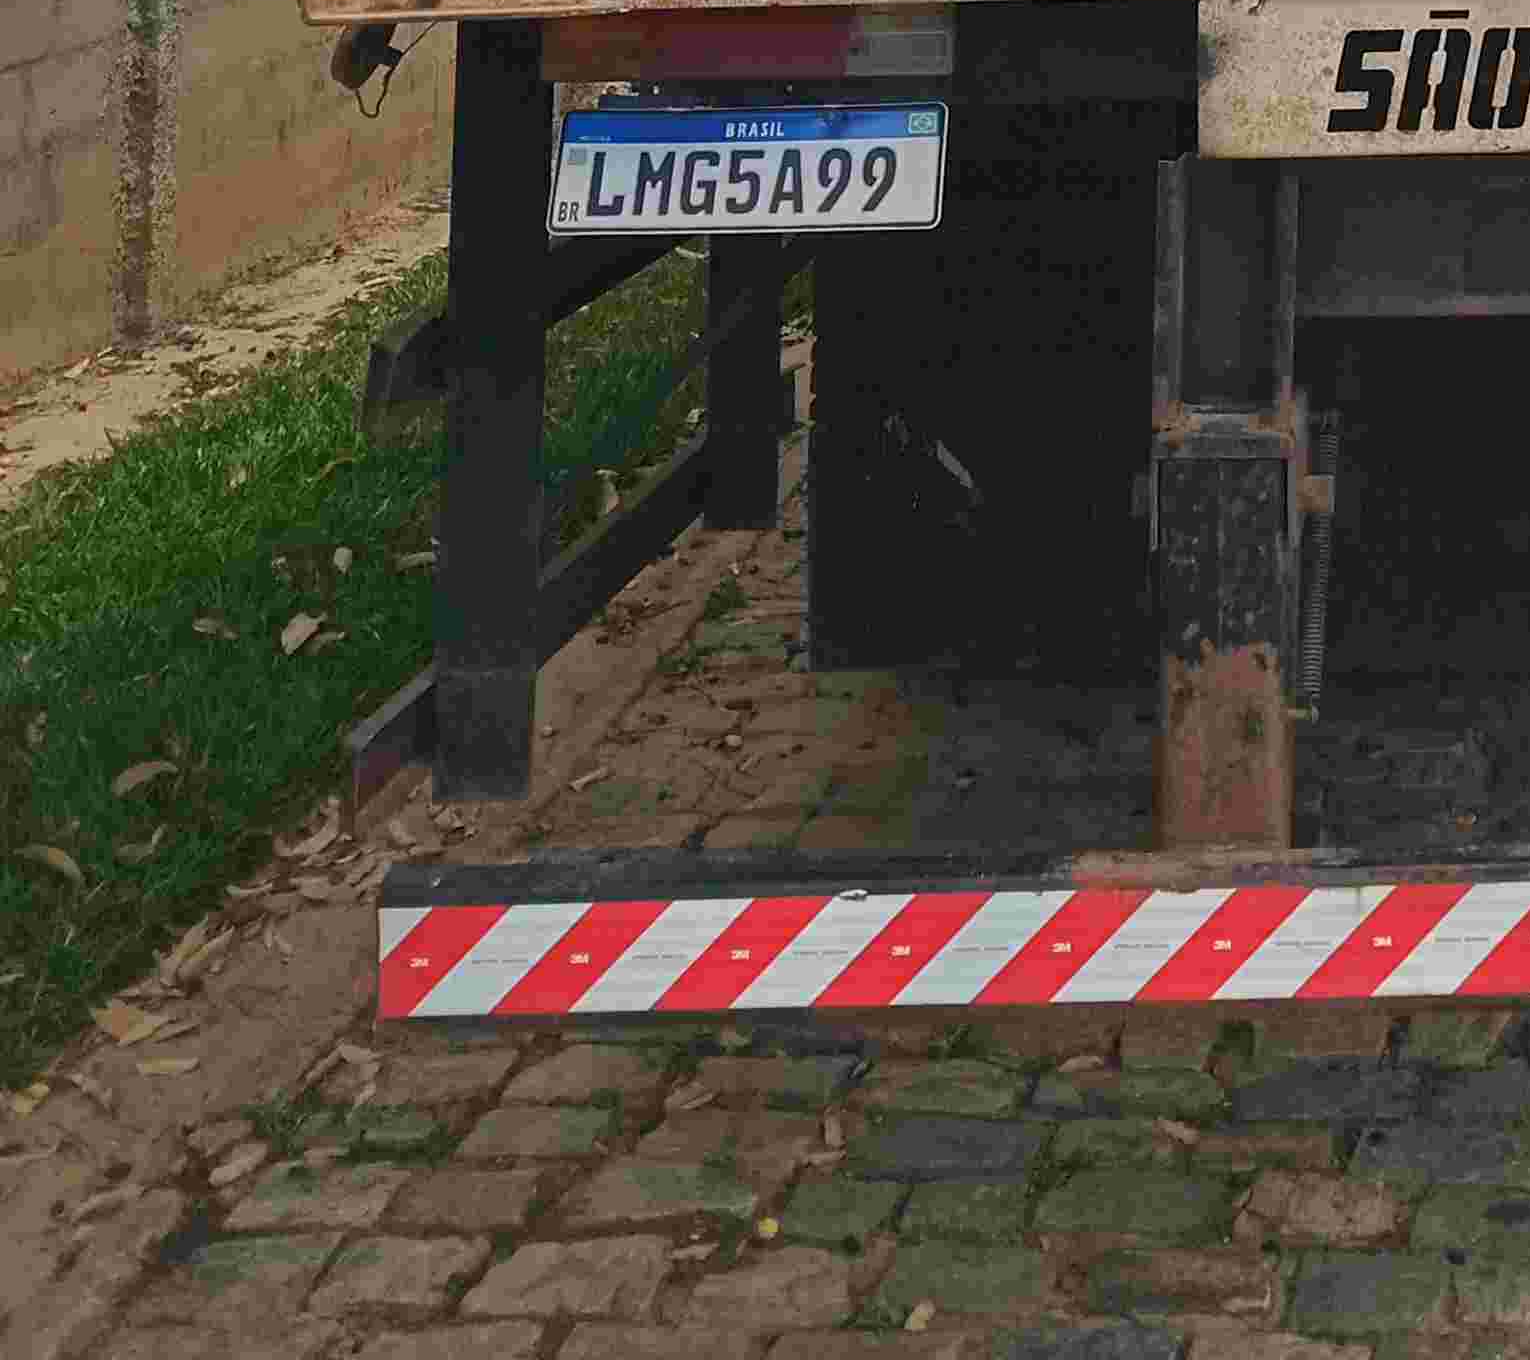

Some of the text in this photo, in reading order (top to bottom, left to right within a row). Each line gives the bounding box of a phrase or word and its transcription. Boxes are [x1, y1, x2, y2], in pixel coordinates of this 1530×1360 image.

[724, 121, 785, 138] BRASIL
[586, 148, 898, 217] LMG5A99
[556, 200, 579, 223] BR
[1213, 939, 1232, 950] 3M
[1373, 935, 1393, 947] 3M
[891, 945, 911, 956] 3M
[1052, 942, 1072, 953] 3M
[570, 953, 590, 964] 3M
[731, 949, 750, 960] 3M
[410, 957, 429, 968] 3M
